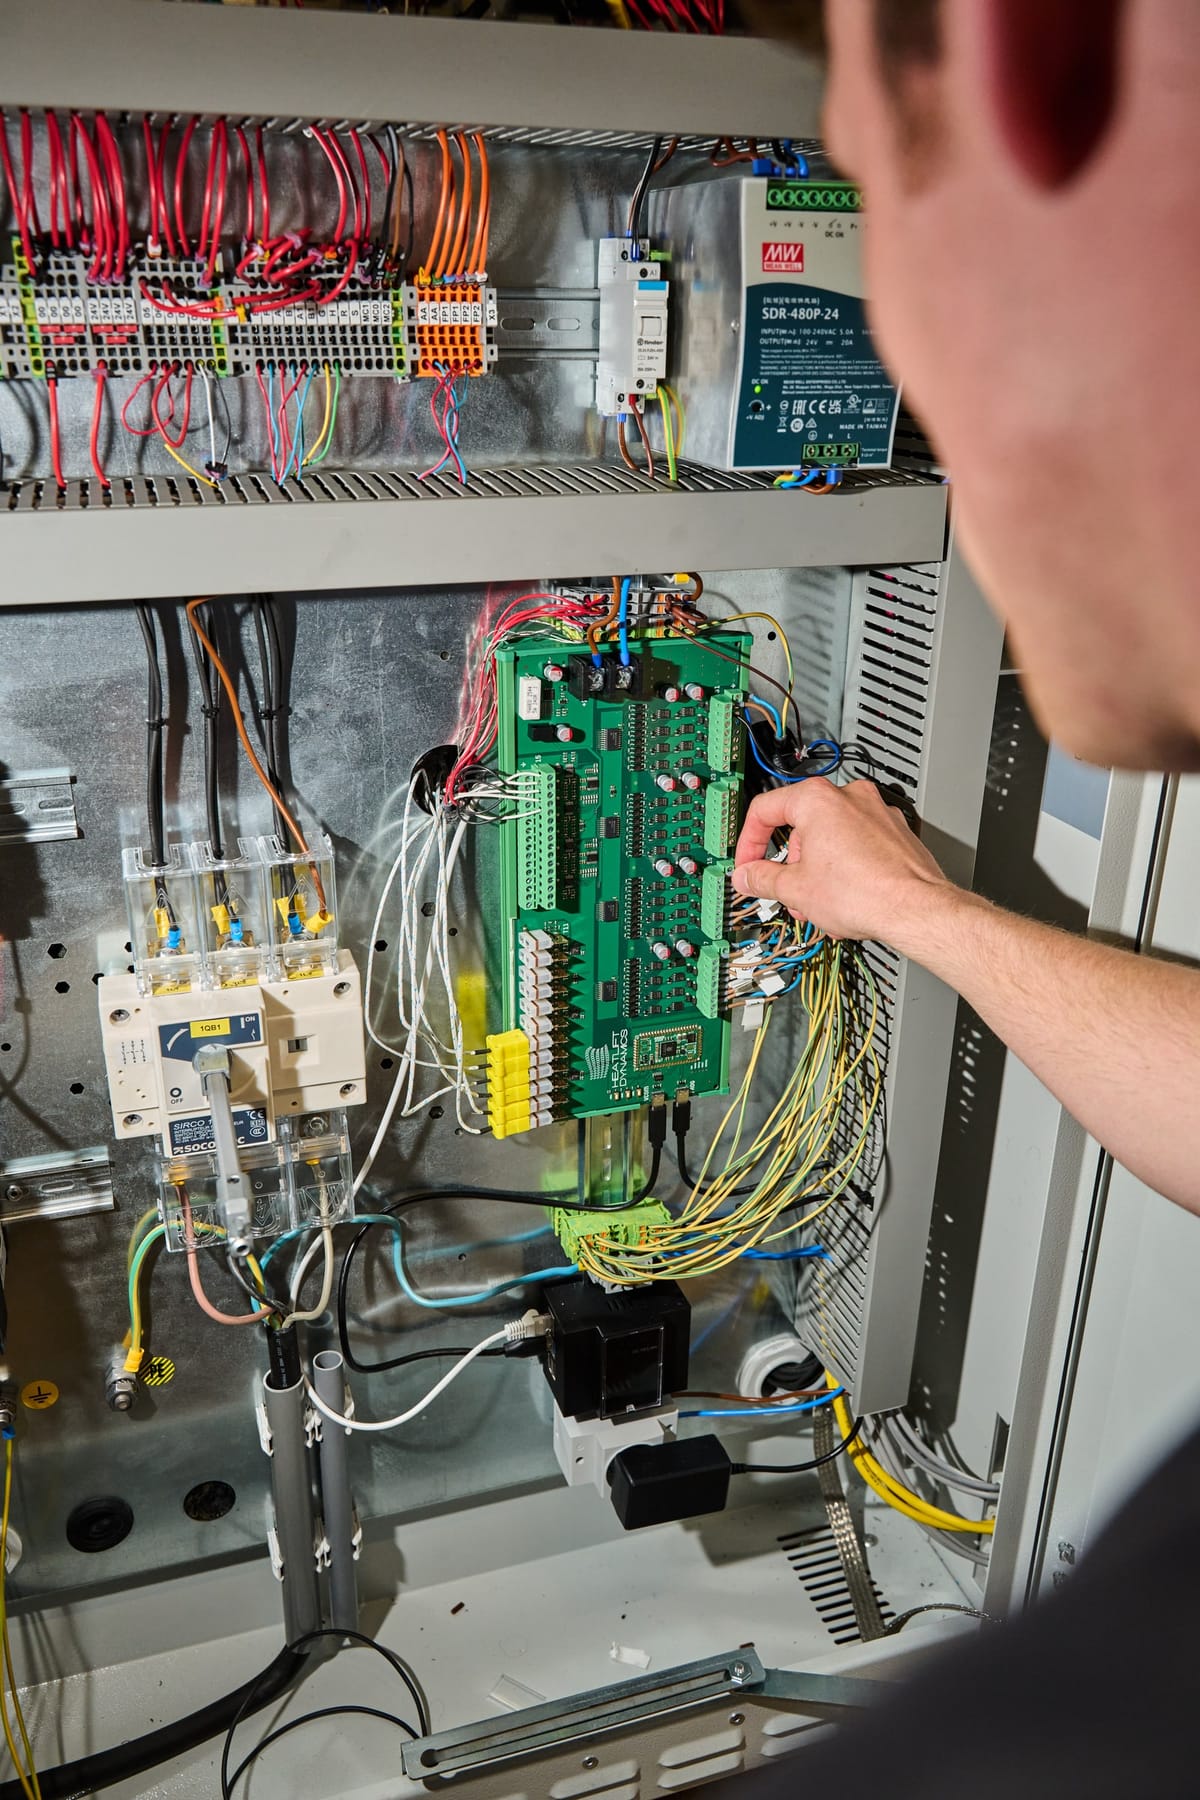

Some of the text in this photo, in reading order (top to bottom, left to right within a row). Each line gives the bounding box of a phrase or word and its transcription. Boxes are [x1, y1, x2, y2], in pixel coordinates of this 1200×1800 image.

[764, 244, 802, 261] MW
[91, 304, 99, 320] 24V
[102, 304, 110, 320] 24V
[113, 304, 121, 320] 24V
[125, 303, 134, 320] 24V
[297, 307, 304, 319] A1
[308, 307, 314, 319] B1
[421, 307, 428, 320] AA
[431, 307, 439, 320] AA
[489, 310, 496, 320] X3
[762, 307, 839, 320] SDR-480P-24
[200, 1024, 221, 1032] 1QB1
[174, 1119, 205, 1130] SIRCO
[151, 1363, 165, 1378] PE
